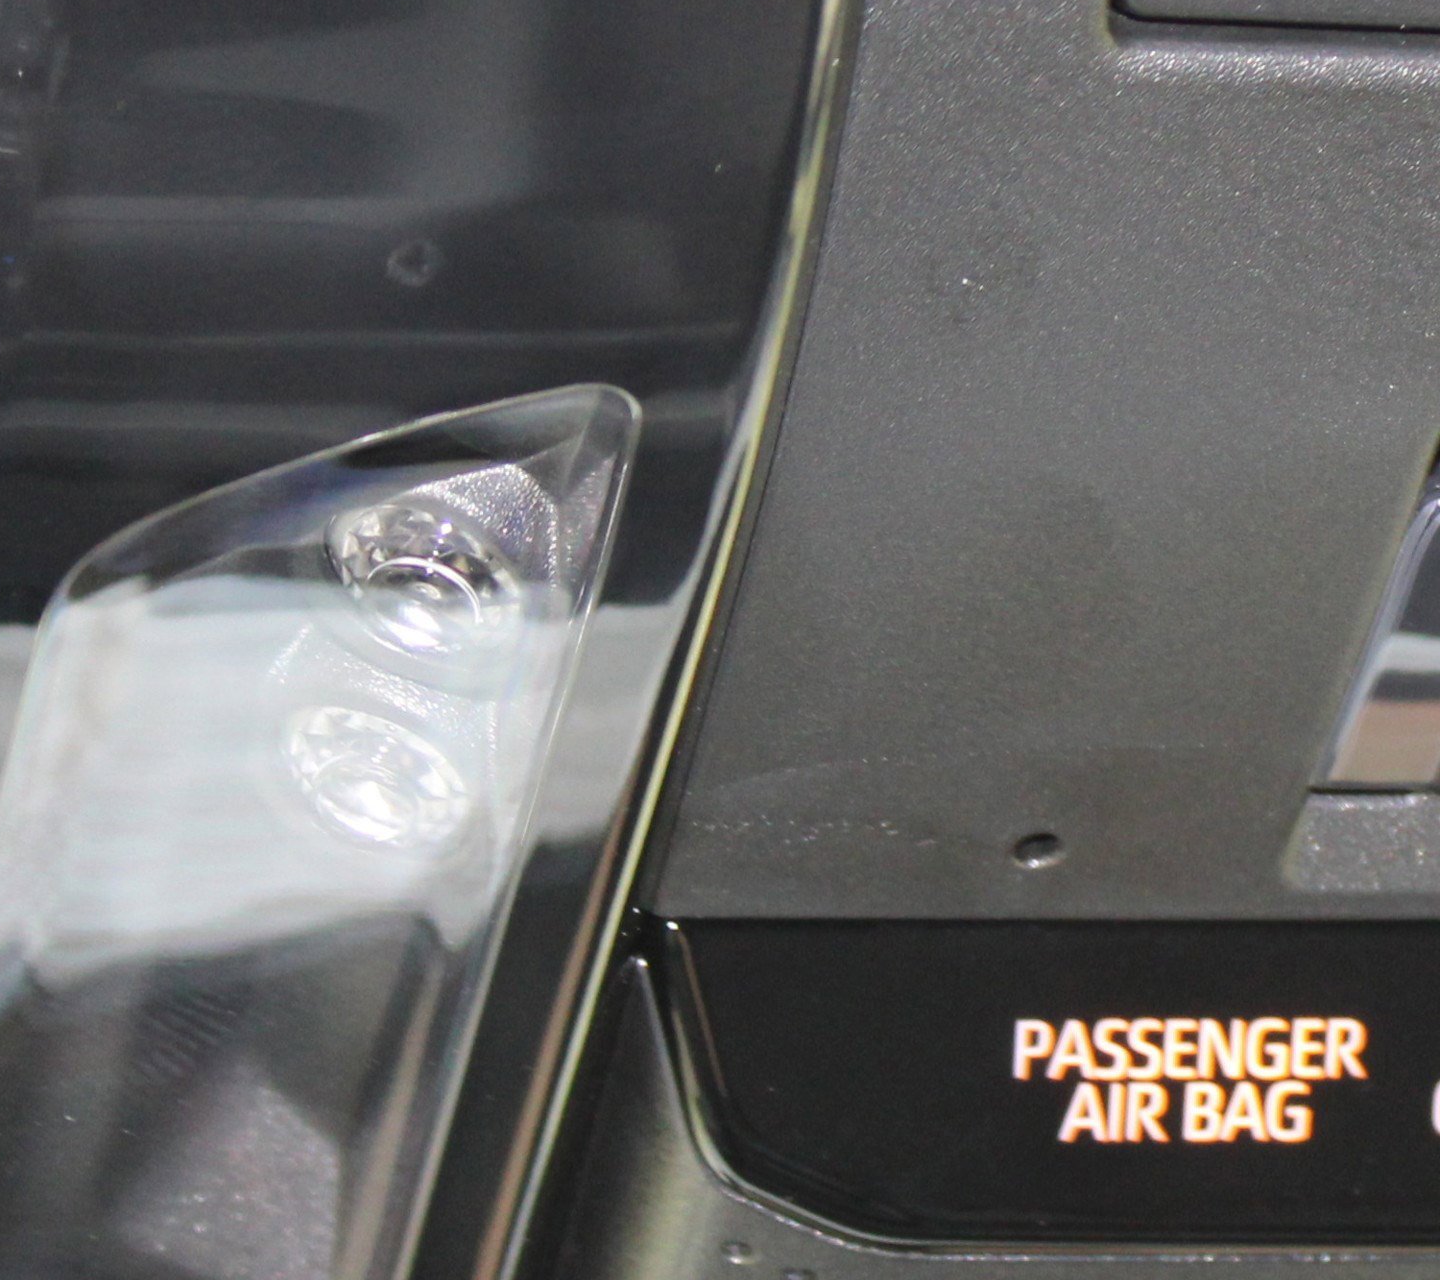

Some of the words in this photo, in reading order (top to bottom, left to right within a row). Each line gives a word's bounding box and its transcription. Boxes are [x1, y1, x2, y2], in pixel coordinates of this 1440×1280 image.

[1013, 1017, 1368, 1080] PASSENGER
[1058, 1080, 1171, 1143] AIR
[1181, 1080, 1314, 1143] BAG
